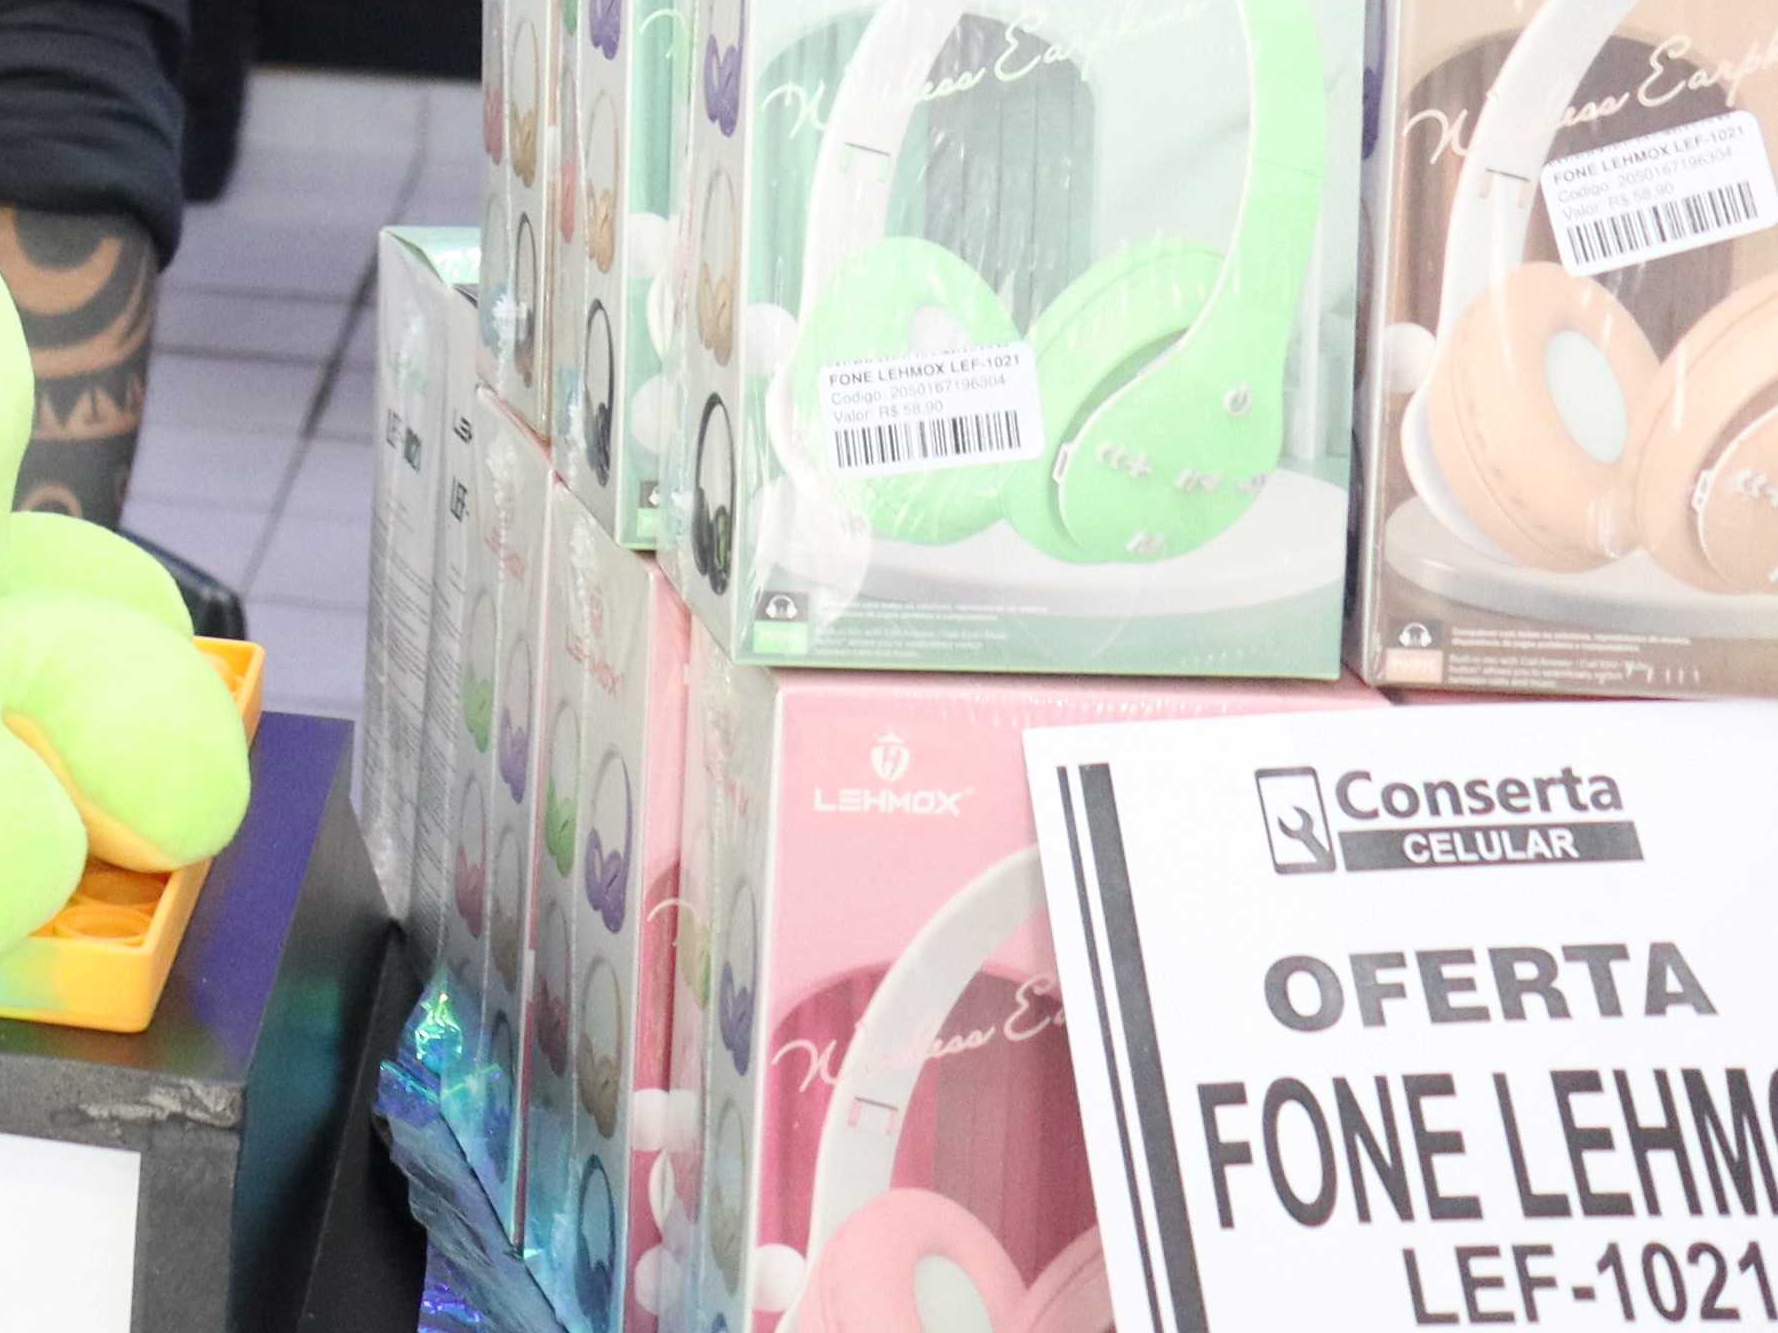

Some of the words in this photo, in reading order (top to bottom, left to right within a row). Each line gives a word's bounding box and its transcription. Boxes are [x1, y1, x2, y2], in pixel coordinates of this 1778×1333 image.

[1552, 164, 1598, 186] FONE
[1602, 146, 1670, 173] LEHMOX
[1674, 124, 1745, 154] LEF-1021
[829, 369, 873, 387] FONE
[877, 362, 945, 383] LEHMOX
[950, 353, 1021, 374] LEF-1021
[878, 404, 900, 420] R$
[813, 787, 964, 818] LEHMOX
[1334, 766, 1625, 822] Conserta
[1401, 831, 1581, 864] CELULAR
[1262, 941, 1719, 1034] OFERTA
[1197, 1073, 1484, 1229] FONE
[1492, 1068, 1778, 1220] LEHMO
[1401, 1240, 1778, 1327] LEF-1021
